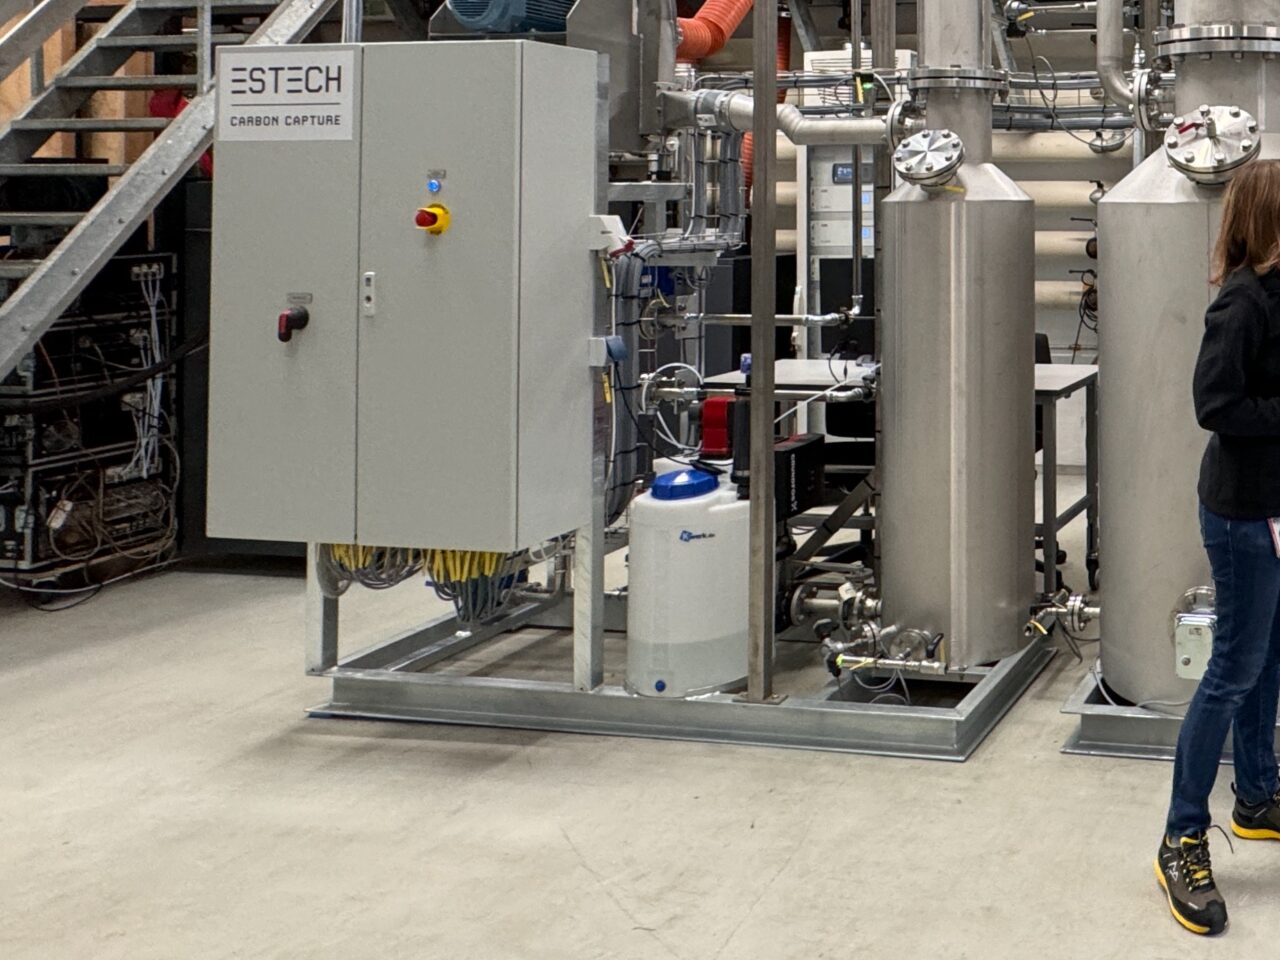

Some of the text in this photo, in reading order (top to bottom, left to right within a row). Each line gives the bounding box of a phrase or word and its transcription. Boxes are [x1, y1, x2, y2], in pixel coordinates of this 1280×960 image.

[231, 65, 342, 94] ESTECH
[230, 114, 341, 127] CARBON CAPTURE
